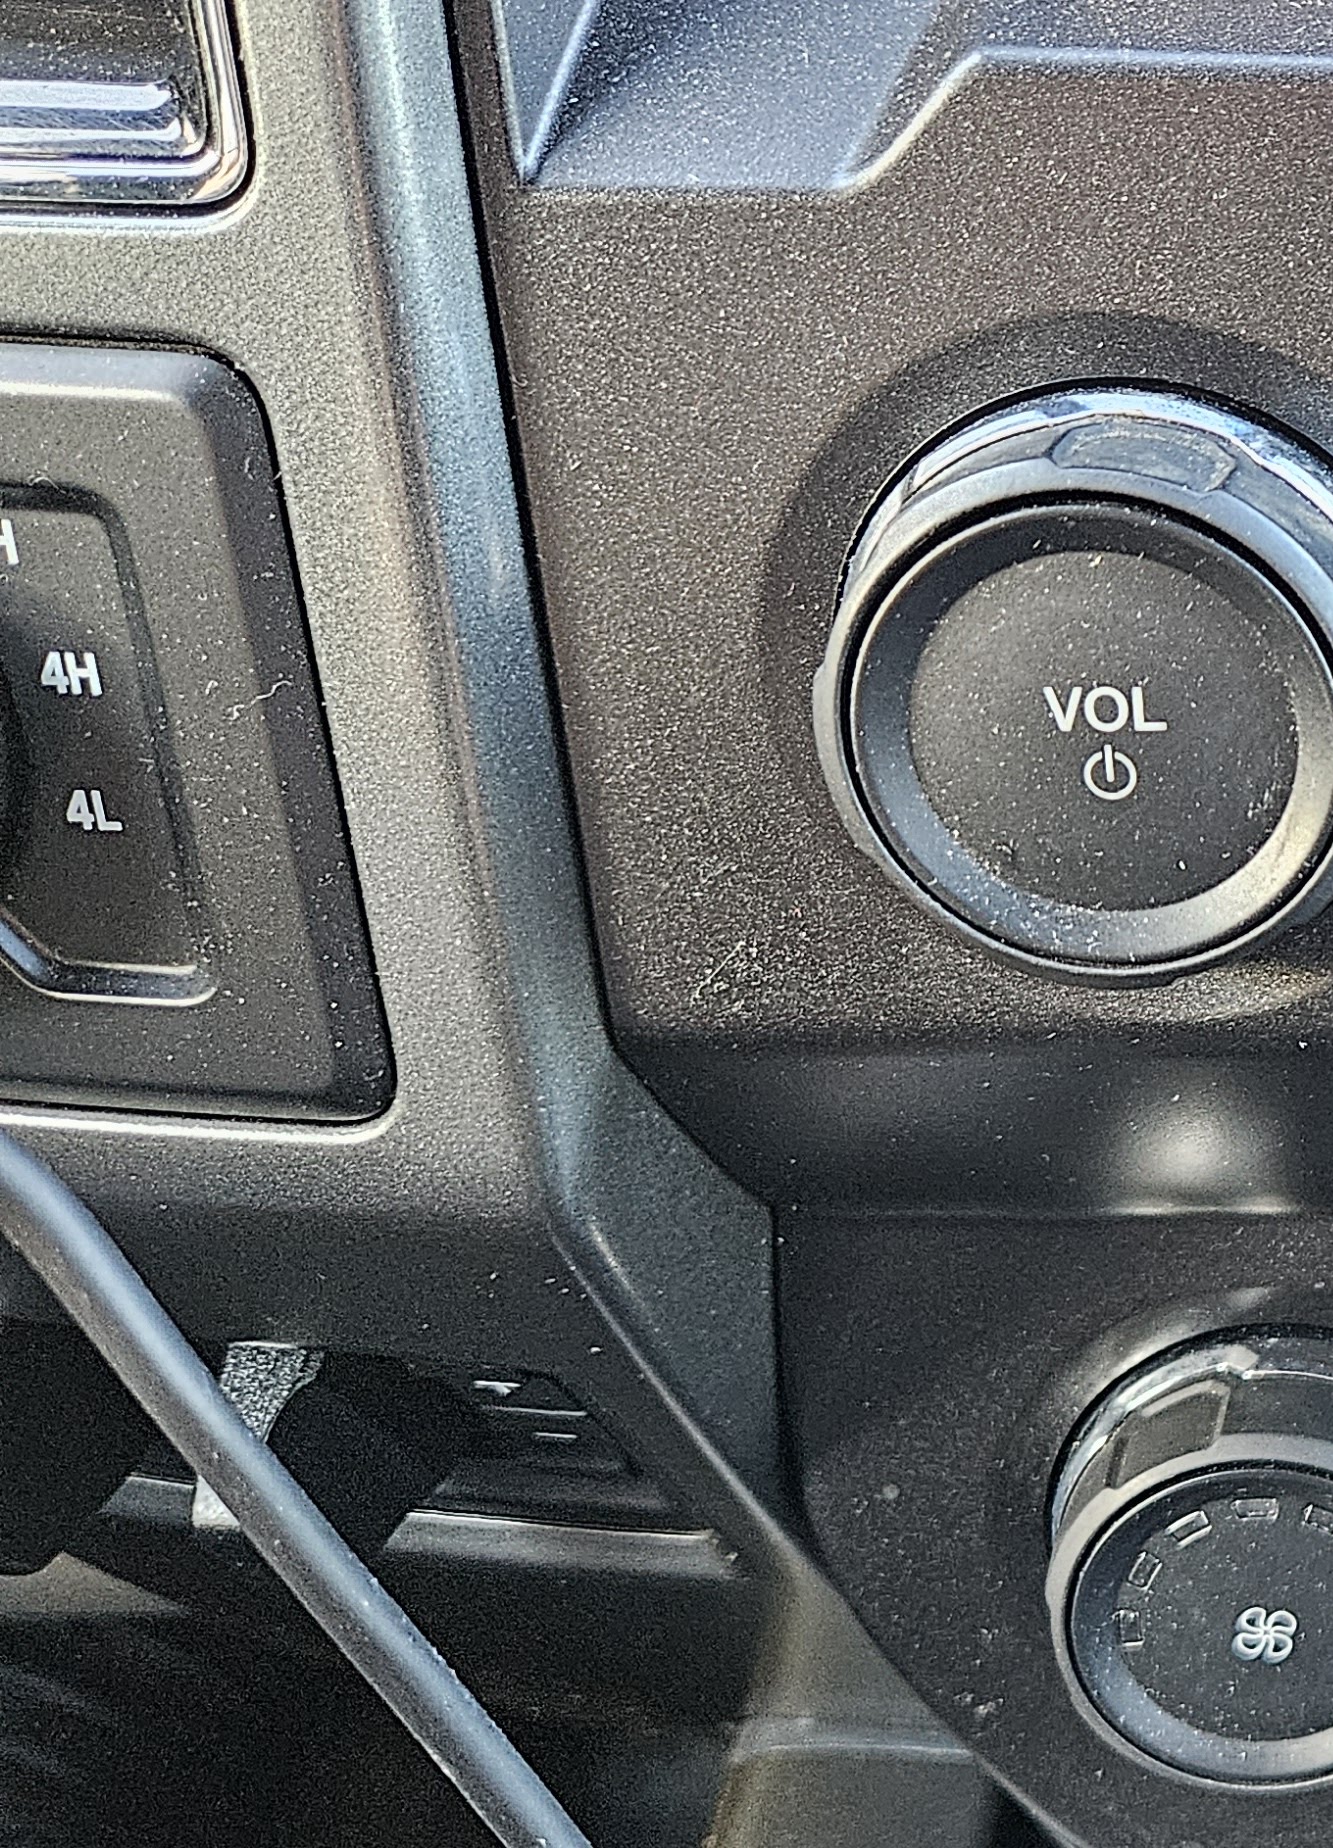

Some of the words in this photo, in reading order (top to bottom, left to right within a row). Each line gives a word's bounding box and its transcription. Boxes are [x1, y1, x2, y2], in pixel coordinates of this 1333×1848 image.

[40, 651, 103, 697] 4H
[1043, 685, 1168, 733] VOL
[66, 789, 124, 832] 4L
